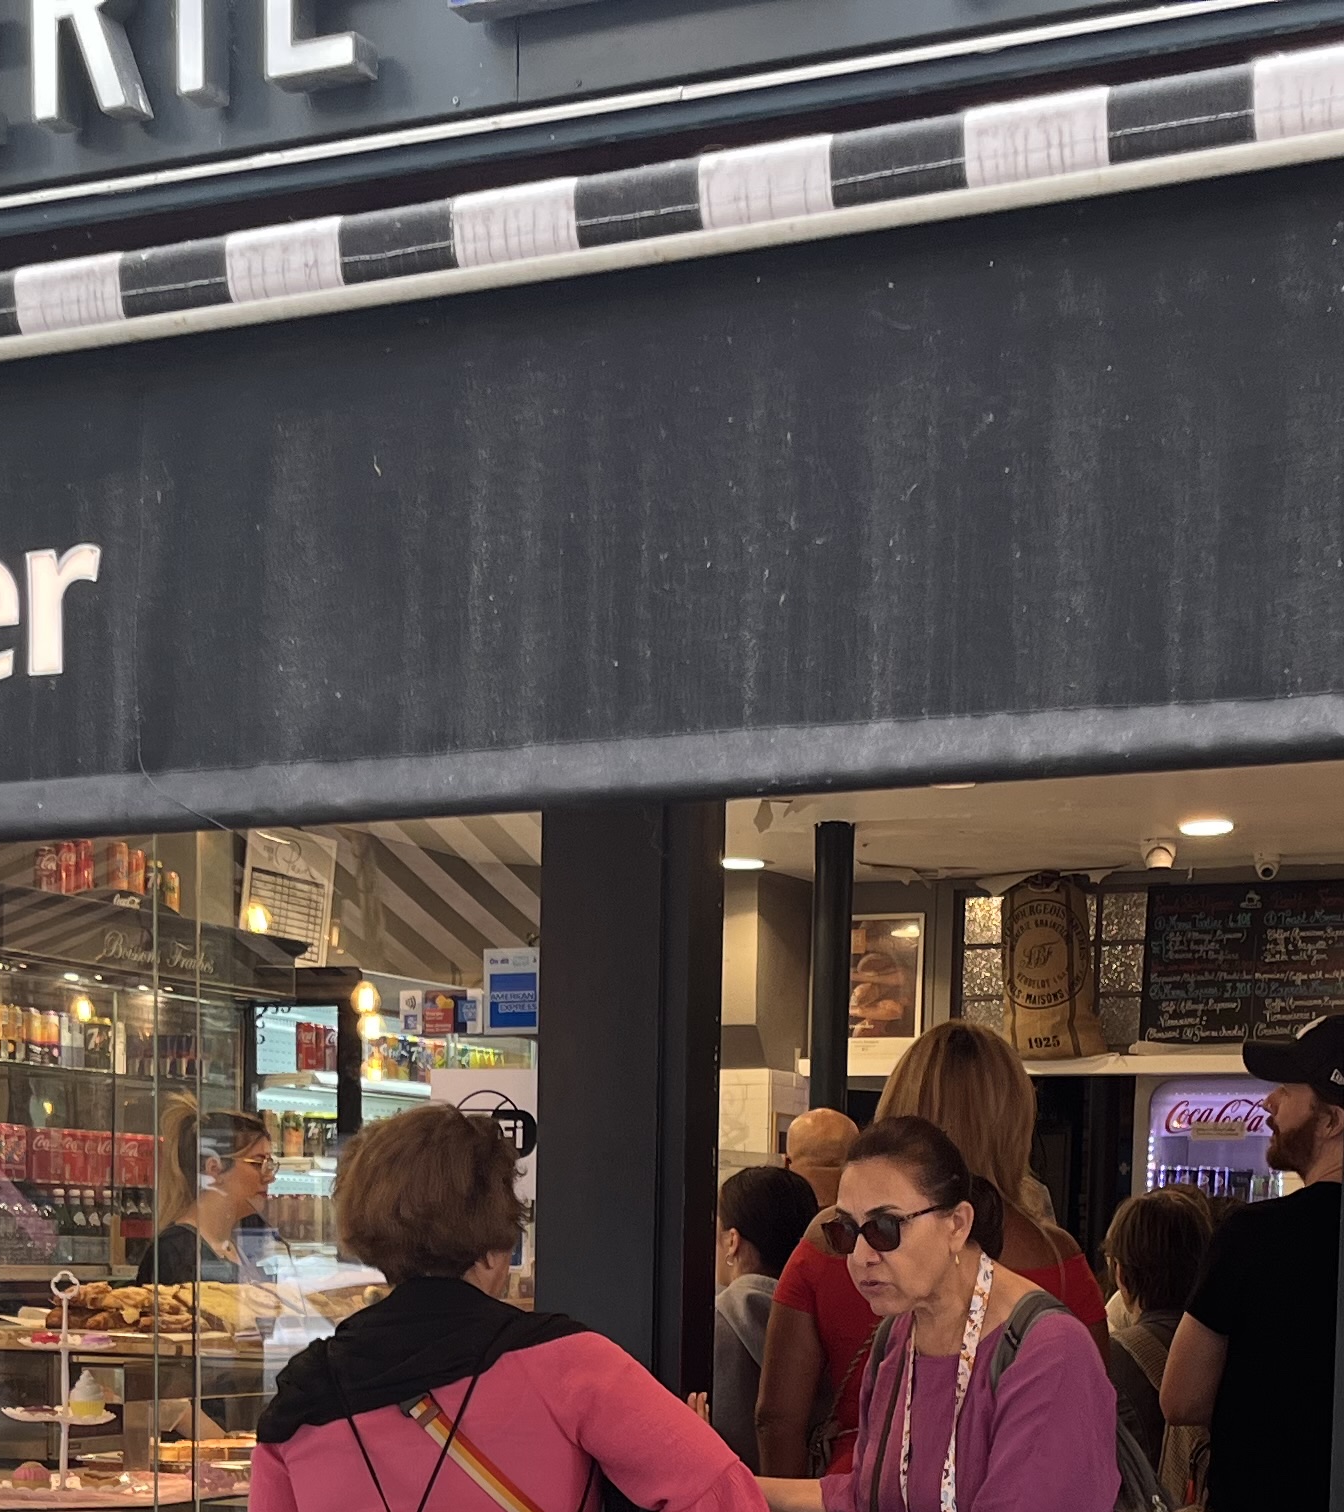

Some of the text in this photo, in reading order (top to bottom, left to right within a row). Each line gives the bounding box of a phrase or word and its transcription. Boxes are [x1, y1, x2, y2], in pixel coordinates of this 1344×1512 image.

[491, 992, 534, 1001] AMERICAN
[499, 1002, 537, 1012] EXPRESS
[1027, 1035, 1061, 1050] 1925
